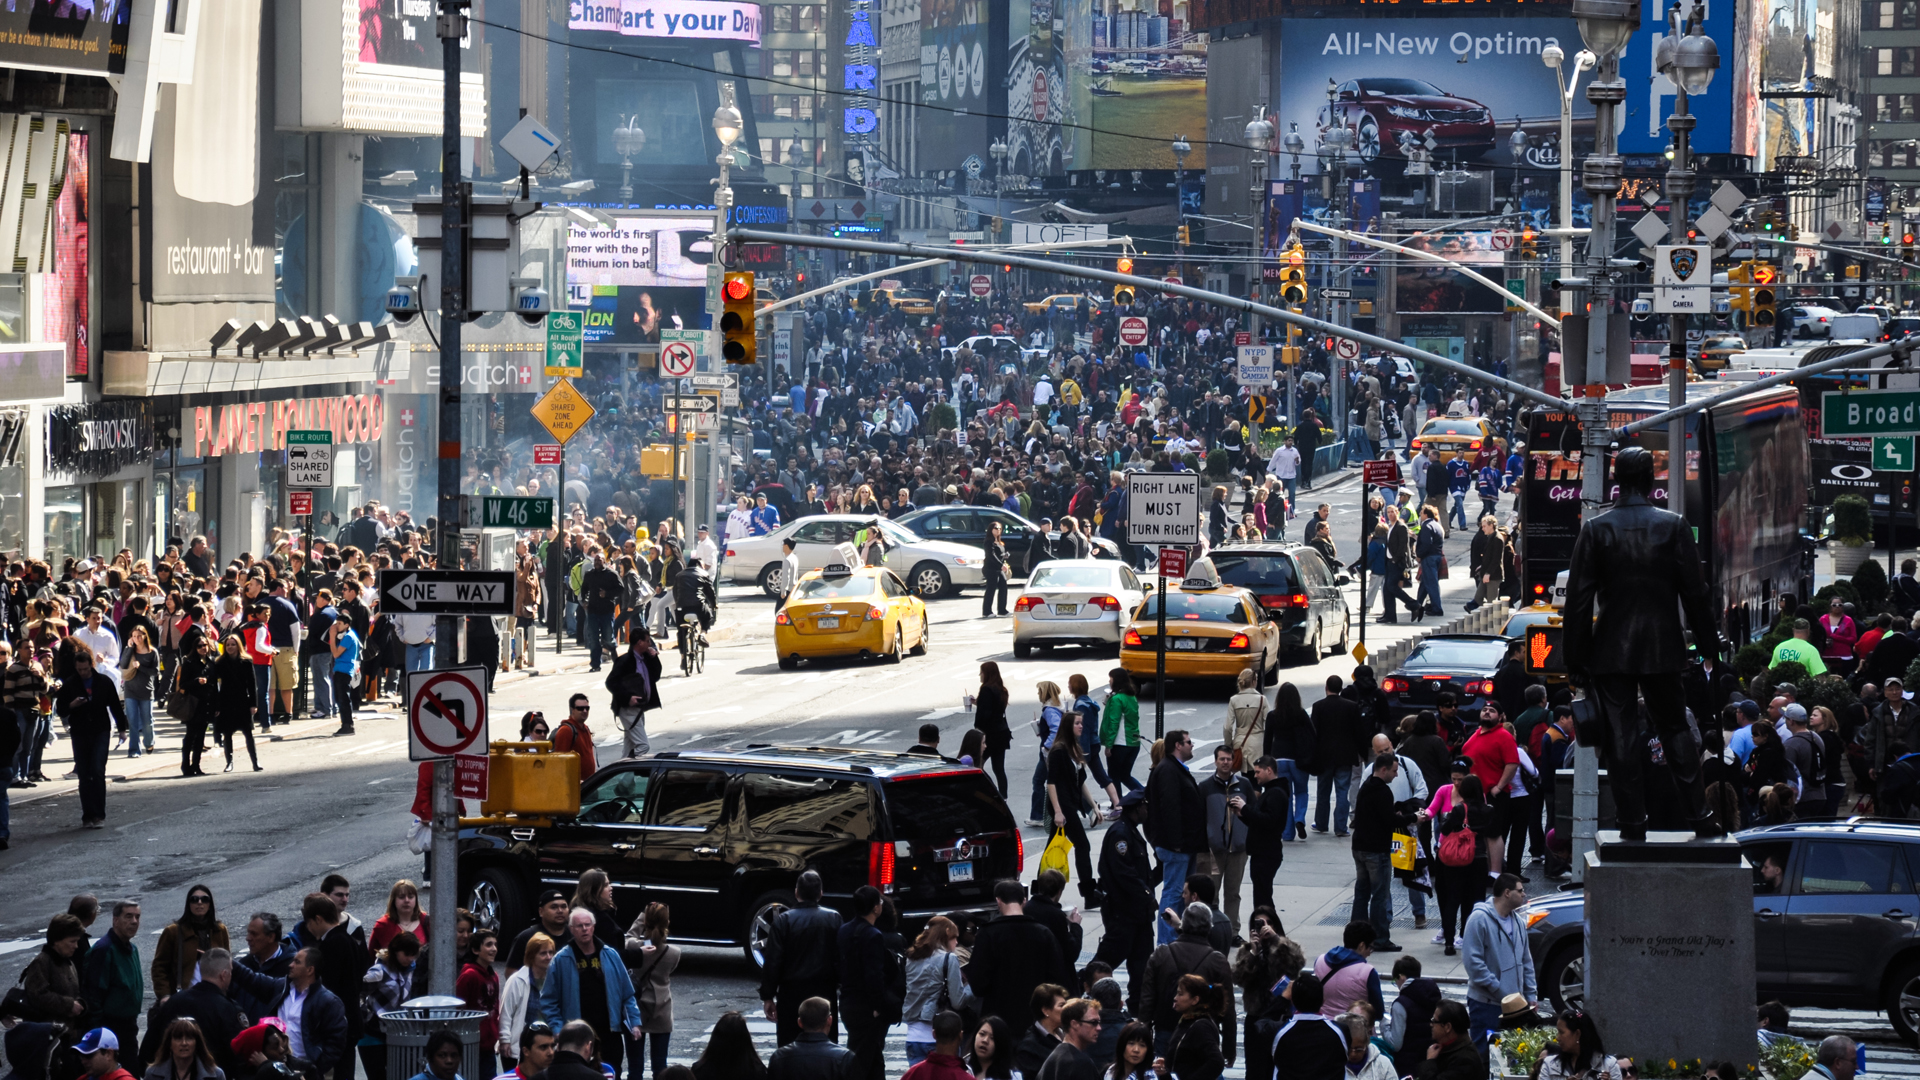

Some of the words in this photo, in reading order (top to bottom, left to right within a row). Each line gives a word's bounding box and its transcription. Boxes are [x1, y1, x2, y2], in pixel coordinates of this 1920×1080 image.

[620, 8, 655, 29] art
[663, 12, 727, 35] your
[732, 9, 755, 38] Day
[8, 27, 16, 44] be
[18, 33, 23, 44] a
[49, 32, 70, 49] should
[70, 34, 78, 50] be
[79, 39, 83, 50] a
[1322, 32, 1439, 56] All-New
[1449, 31, 1560, 60] Optima
[567, 228, 587, 239] The
[590, 228, 630, 239] world's
[1025, 224, 1094, 244] LOFT
[595, 244, 619, 255] with
[620, 244, 639, 255] the
[167, 237, 231, 275] restaurant
[244, 238, 265, 275] bar
[571, 258, 609, 269] lithium
[612, 258, 630, 269] ion
[388, 294, 410, 308] NYPD
[518, 296, 541, 309] NYPD
[1672, 300, 1694, 308] CAMERA
[662, 331, 680, 339] GEORGE
[681, 331, 702, 339] ABBOTT
[552, 342, 576, 351] South
[774, 342, 789, 350] rink
[774, 352, 789, 360] andy
[426, 361, 518, 386] satch
[1241, 371, 1269, 380] CAMERA
[550, 403, 576, 411] SHARED
[693, 400, 709, 408] WAY
[554, 412, 571, 420] ZONE
[1611, 413, 1632, 421] SEEN
[1848, 401, 1920, 425] Broad
[195, 401, 266, 459] PLANET
[272, 394, 383, 450] HOLLYWOOD
[552, 421, 573, 429] AHEAD
[82, 418, 137, 452] SWAROVSKI
[290, 462, 329, 472] SHARED
[296, 473, 322, 483] LANE
[396, 428, 414, 520] watch
[1820, 478, 1851, 486] OAKLEY
[1132, 482, 1164, 495] RIGHT
[1168, 483, 1196, 495] LANE
[1549, 485, 1578, 502] Get
[488, 499, 502, 524] W
[507, 500, 528, 525] 46
[534, 500, 549, 514] ST
[1145, 502, 1182, 516] MUST
[1131, 524, 1160, 535] TURN
[1164, 524, 1196, 536] RIGHT
[1167, 552, 1184, 560] STOPPING
[400, 583, 437, 601] ONE
[456, 584, 497, 602] WAY
[456, 759, 465, 769] NO
[465, 759, 486, 771] STOPPING
[460, 771, 481, 782] ANYTIME
[1647, 936, 1653, 945] a
[1656, 935, 1685, 947] Grand
[1686, 935, 1703, 946] Old
[1704, 934, 1726, 949] Flag
[1648, 946, 1669, 957] Over
[1671, 946, 1695, 957] There
